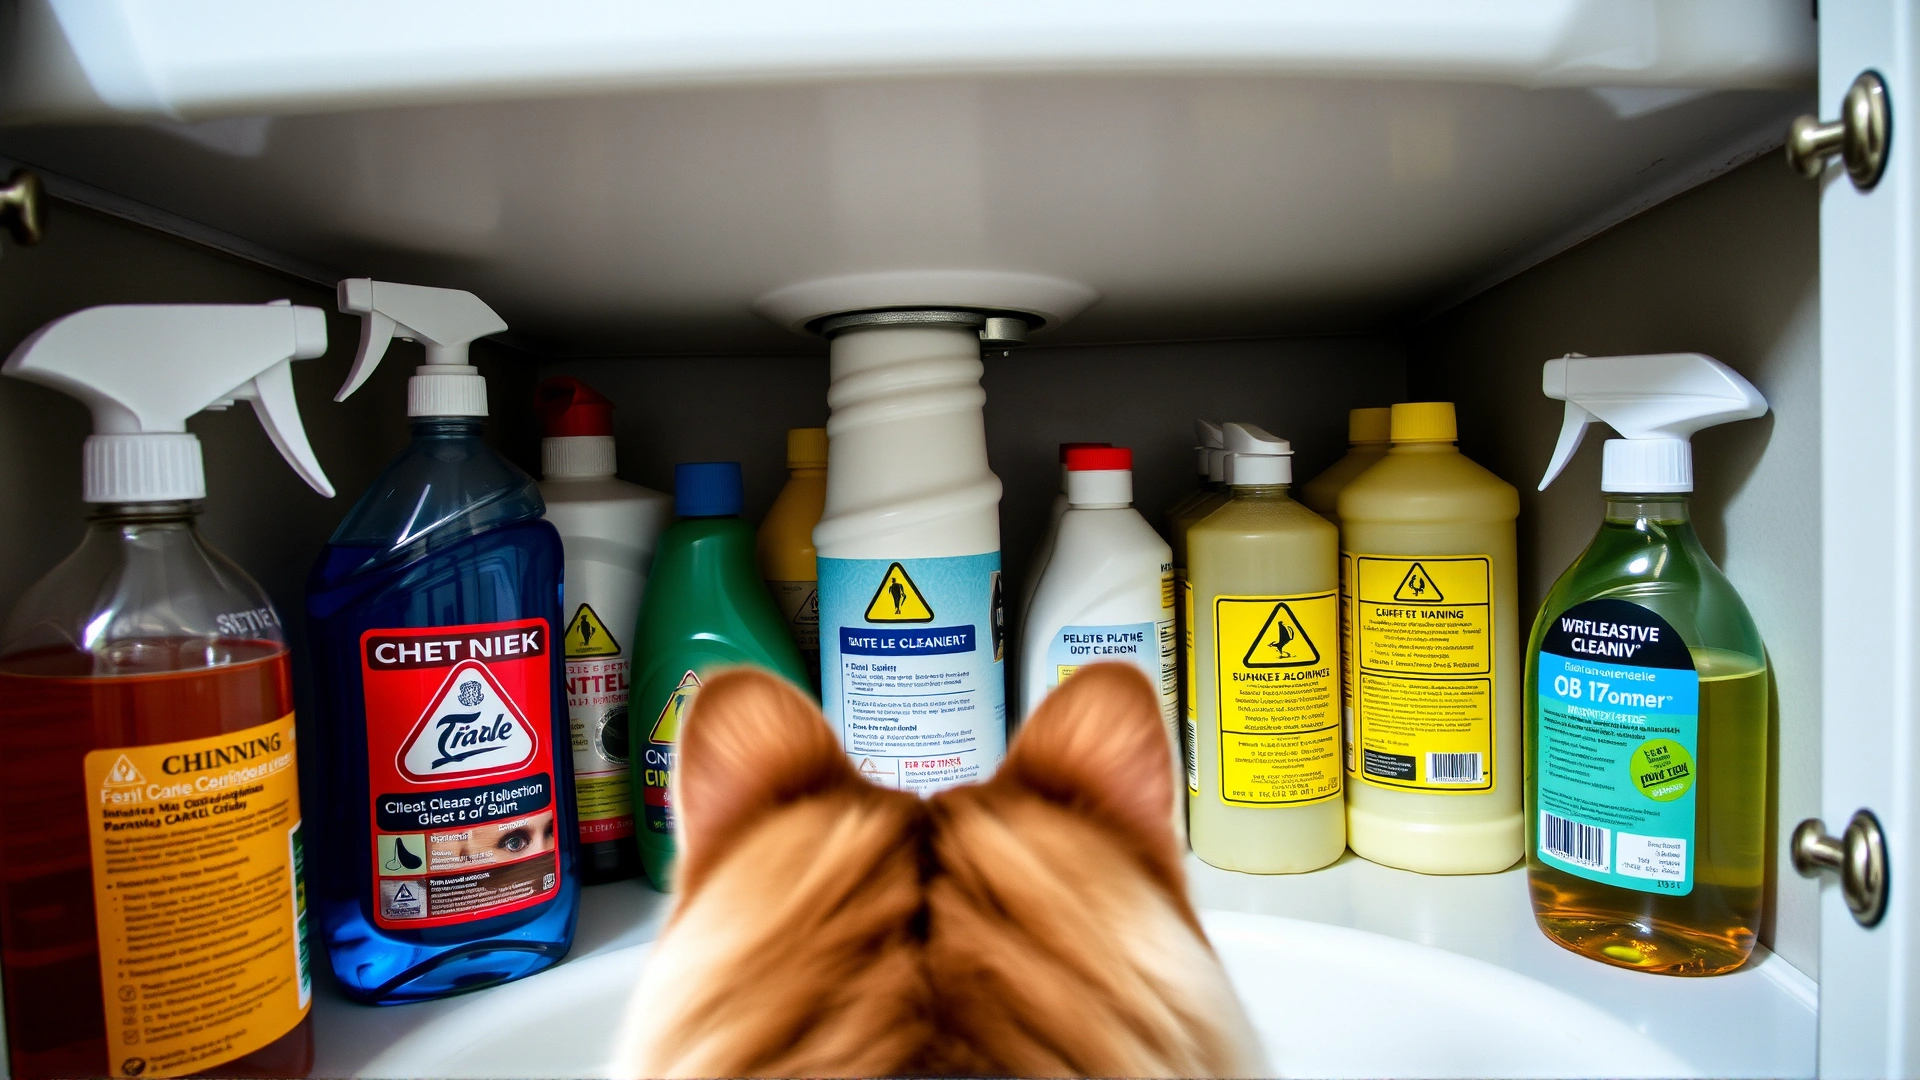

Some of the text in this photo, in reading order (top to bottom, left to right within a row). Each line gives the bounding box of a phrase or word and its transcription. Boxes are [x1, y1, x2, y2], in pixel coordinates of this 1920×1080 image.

[375, 630, 540, 664] CHET NIEK
[1554, 675, 1582, 699] OB
[162, 732, 281, 776] CHINNING
